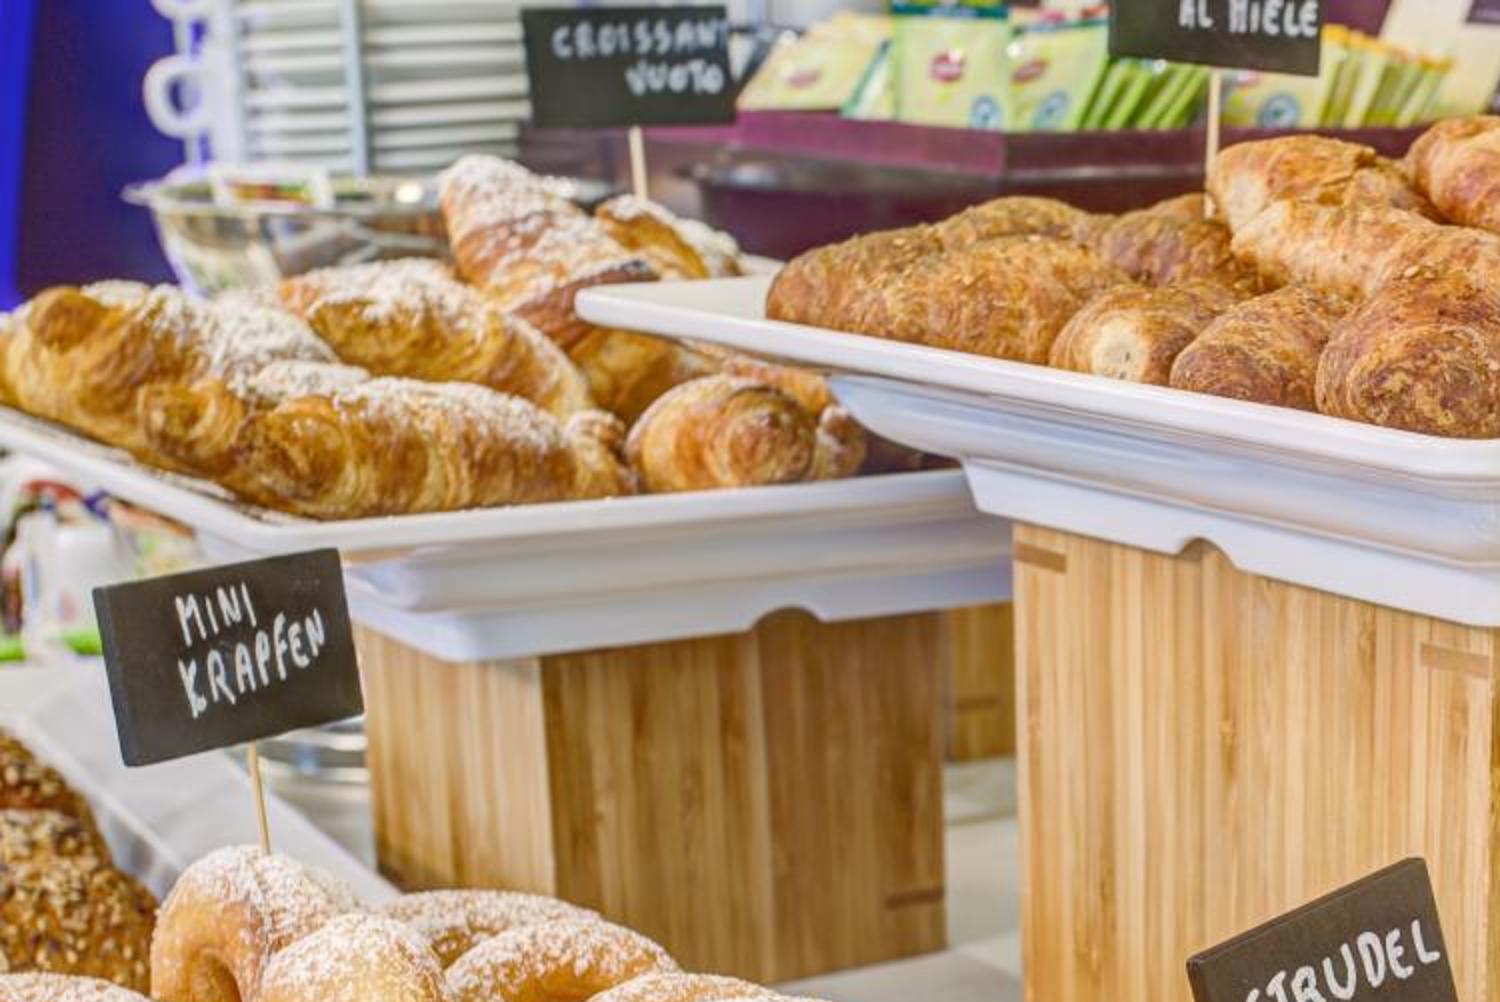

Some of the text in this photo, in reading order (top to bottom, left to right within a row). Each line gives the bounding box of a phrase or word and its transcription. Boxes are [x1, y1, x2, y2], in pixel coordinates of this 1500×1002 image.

[1178, 0, 1213, 29] AL
[624, 58, 725, 95] VUOTO
[174, 581, 257, 647] MINI
[177, 607, 326, 720] KRAPFEN
